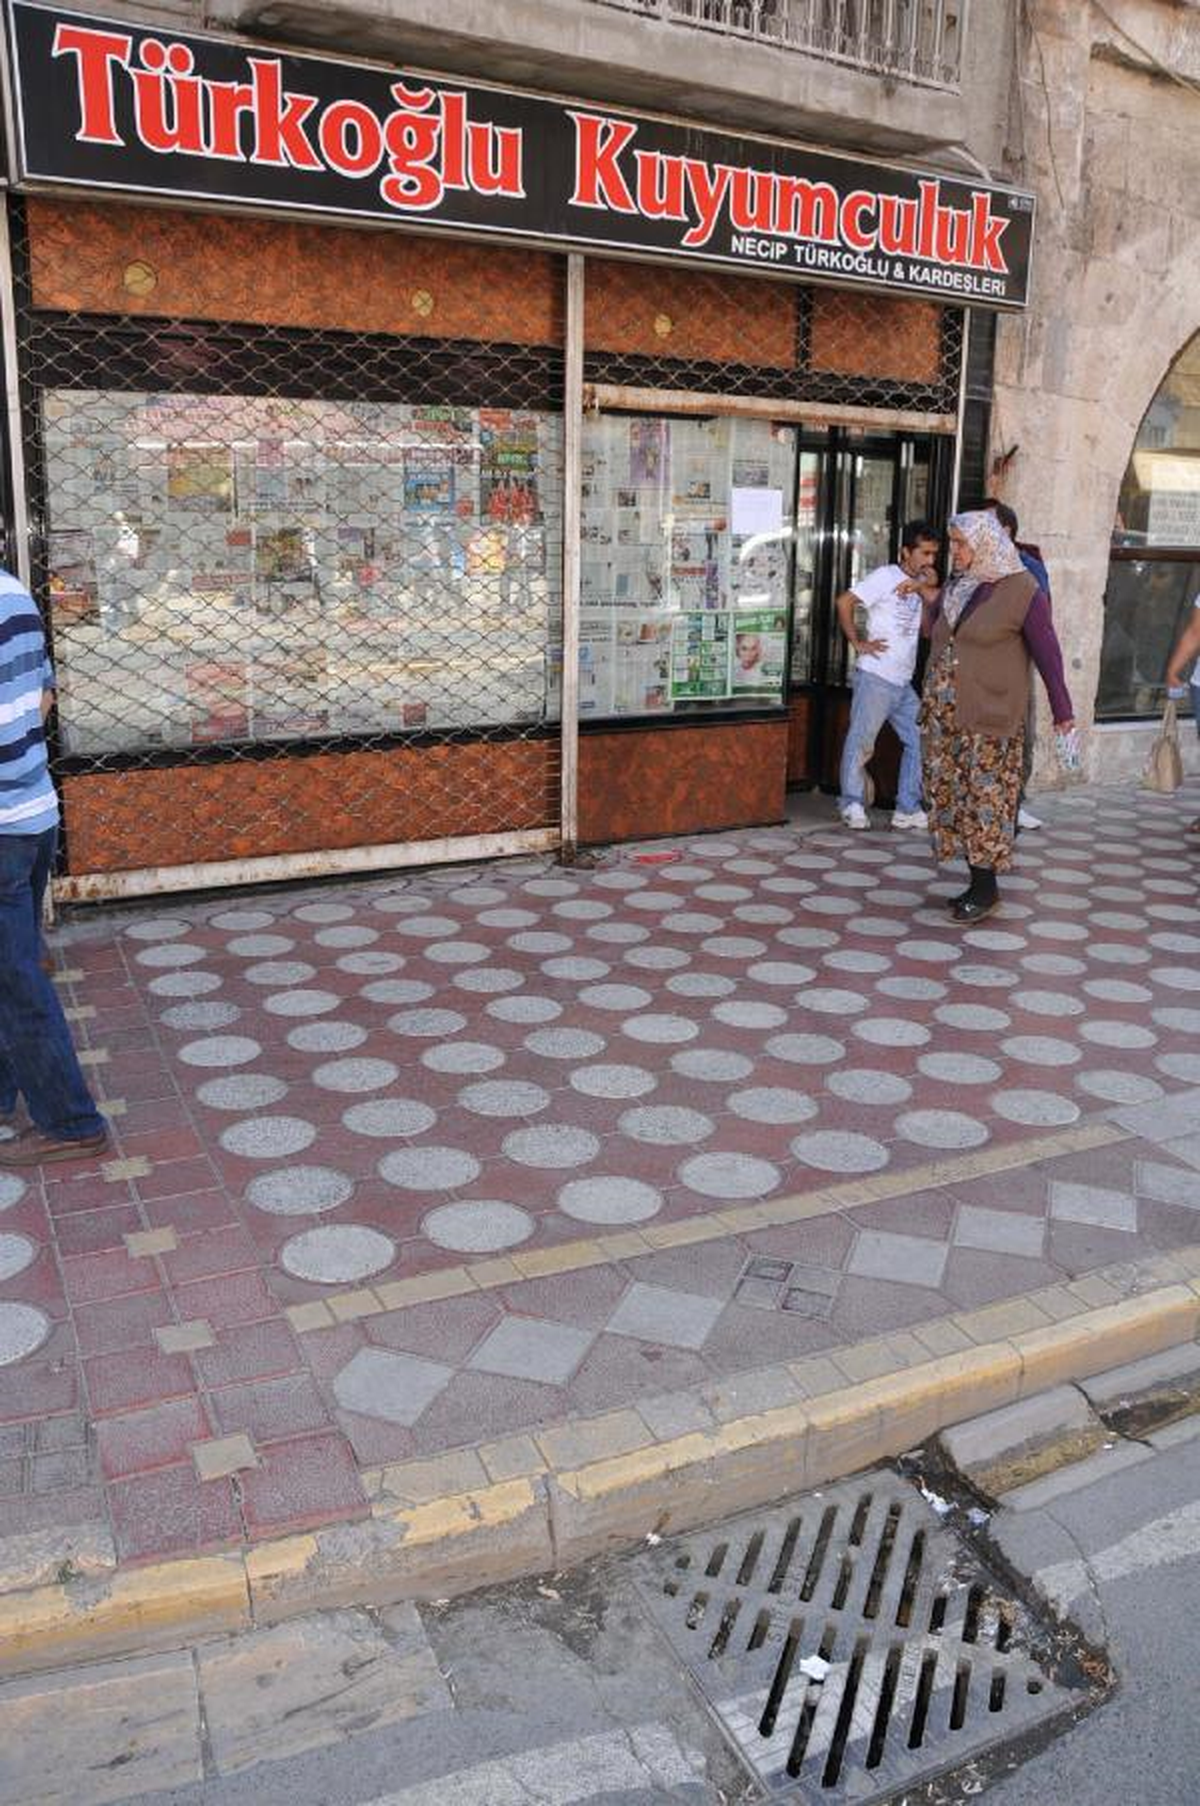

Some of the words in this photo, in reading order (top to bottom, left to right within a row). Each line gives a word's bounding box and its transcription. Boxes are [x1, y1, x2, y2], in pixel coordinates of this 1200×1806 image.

[53, 24, 525, 210] Türkoğlu
[566, 112, 1009, 272] Kuyumculuk
[731, 235, 787, 259] NECİP
[794, 244, 889, 276] TÜRKOĞLU
[893, 264, 905, 279] &
[909, 265, 1006, 296] KARDEŞLERİ
